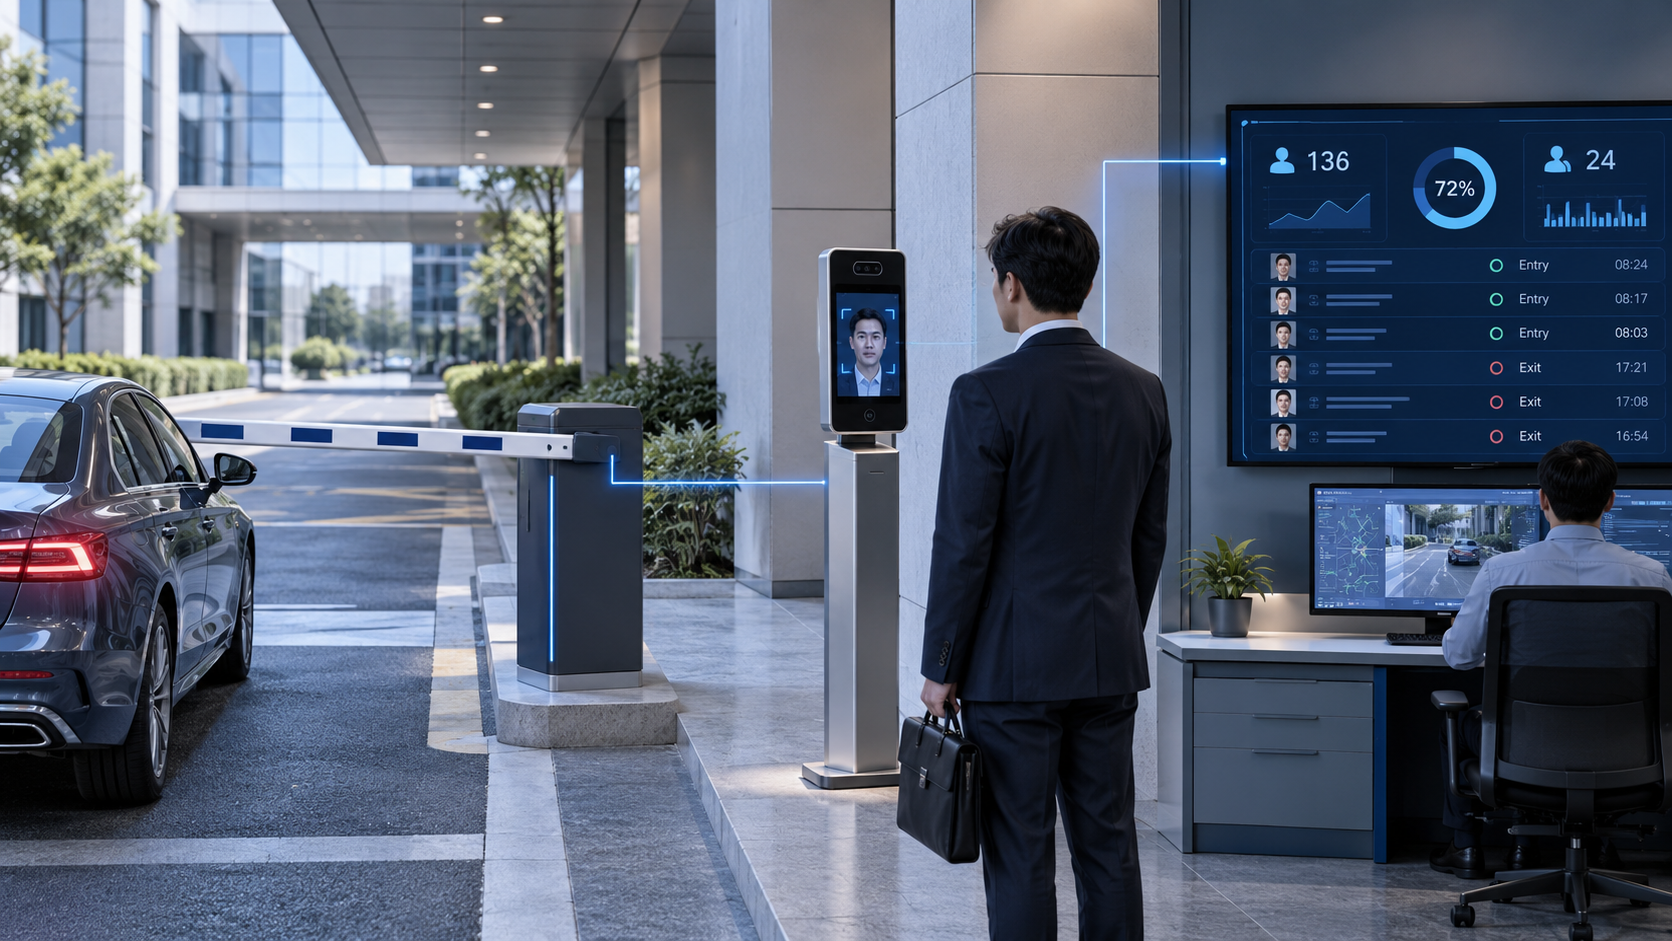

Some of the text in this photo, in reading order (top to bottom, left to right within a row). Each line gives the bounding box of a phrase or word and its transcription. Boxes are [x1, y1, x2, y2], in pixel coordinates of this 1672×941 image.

[1307, 150, 1350, 172] 136
[1586, 149, 1616, 171] 24
[1434, 180, 1475, 197] 72%
[1519, 258, 1649, 273] Entry 08:24
[1519, 292, 1648, 307] Entry 08:17
[1519, 326, 1648, 341] Entry 08:03
[1519, 361, 1648, 374] Exit 17:21
[1519, 395, 1649, 408] Exit 17:08
[1519, 430, 1649, 443] Exit 16:54
